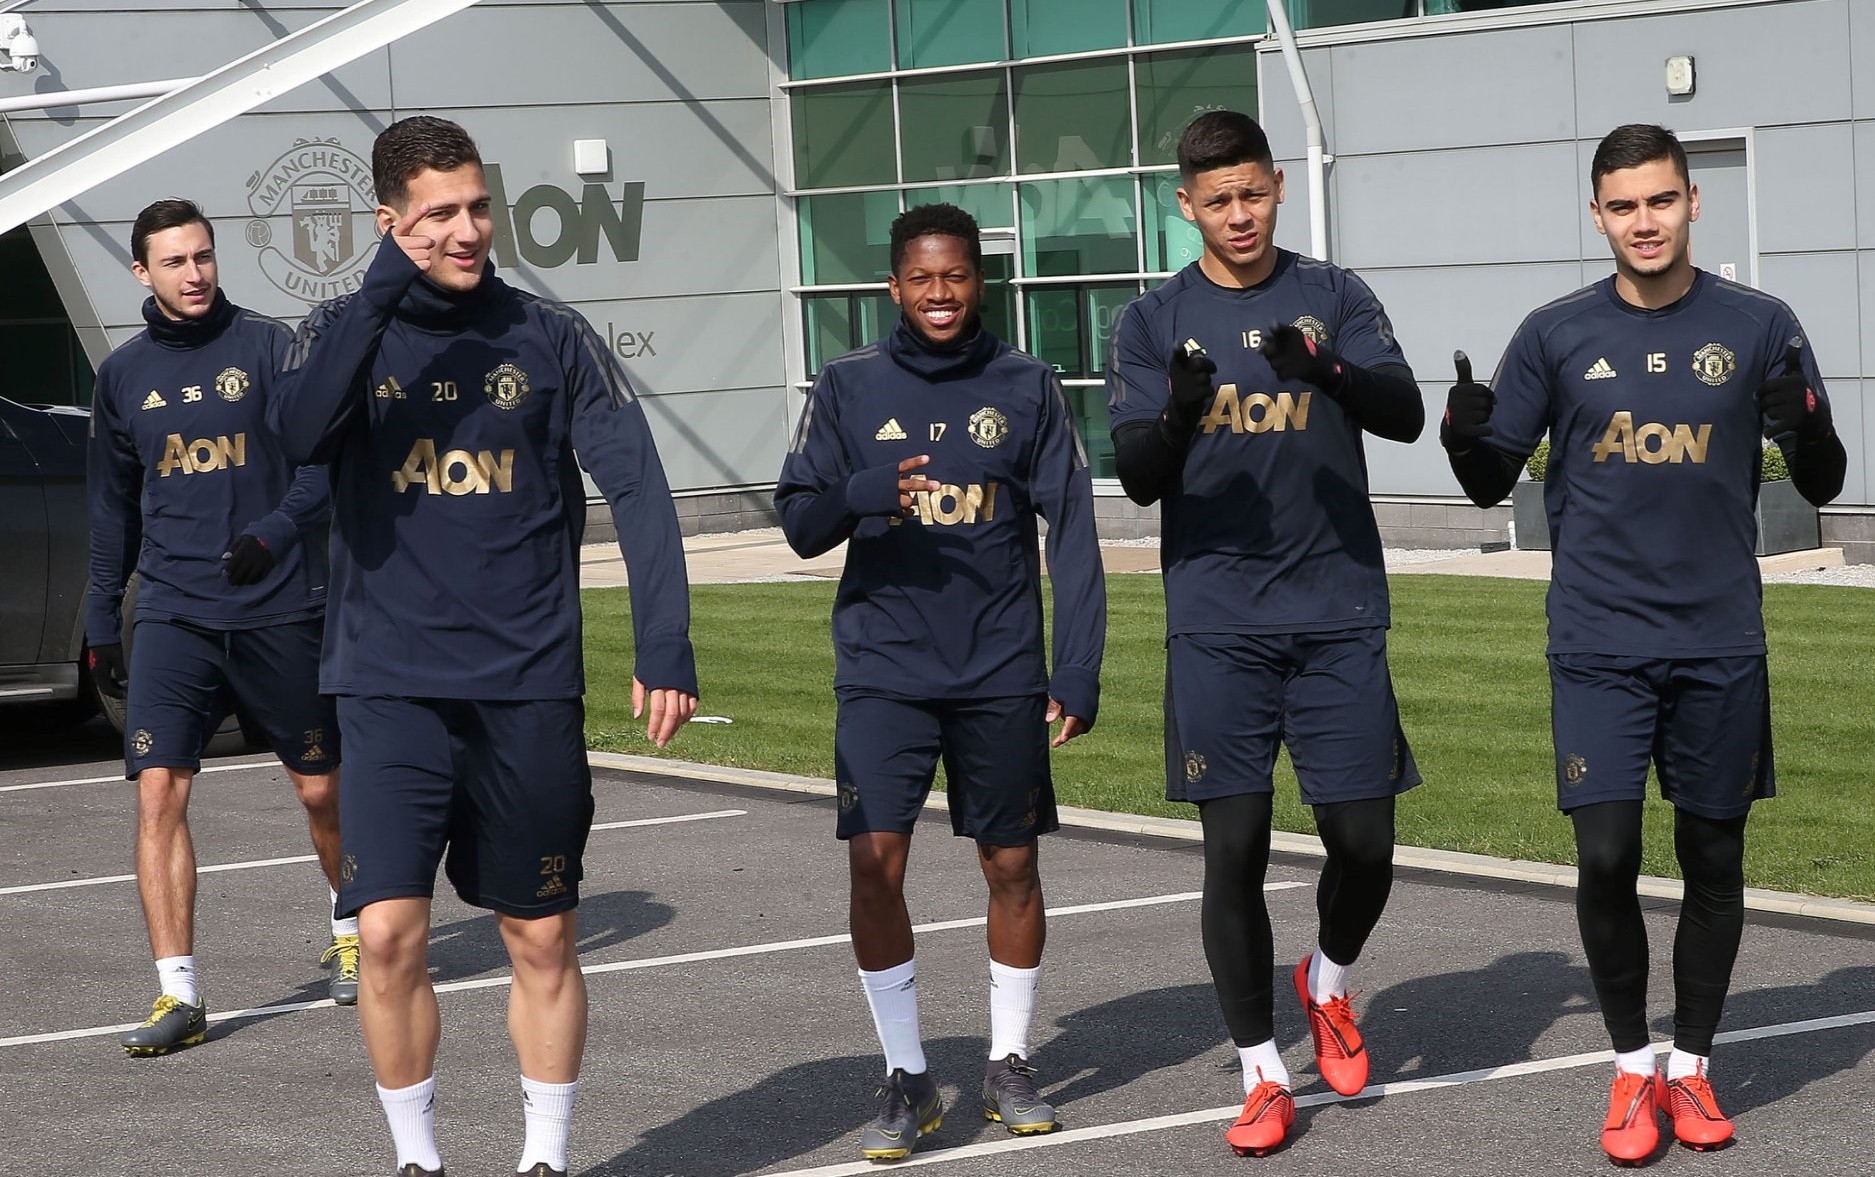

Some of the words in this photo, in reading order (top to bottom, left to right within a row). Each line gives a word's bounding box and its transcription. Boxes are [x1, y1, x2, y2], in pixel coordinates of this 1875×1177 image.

[258, 151, 377, 207] MANCHESTER
[285, 269, 367, 299] UNITED
[1241, 329, 1262, 349] 16
[1647, 352, 1667, 373] 15
[1584, 369, 1617, 380] adidas
[181, 385, 203, 403] 36
[431, 381, 458, 401] 20
[875, 431, 908, 441] adidas
[929, 422, 947, 442] 17
[303, 728, 324, 744] 36
[540, 855, 565, 874] 20
